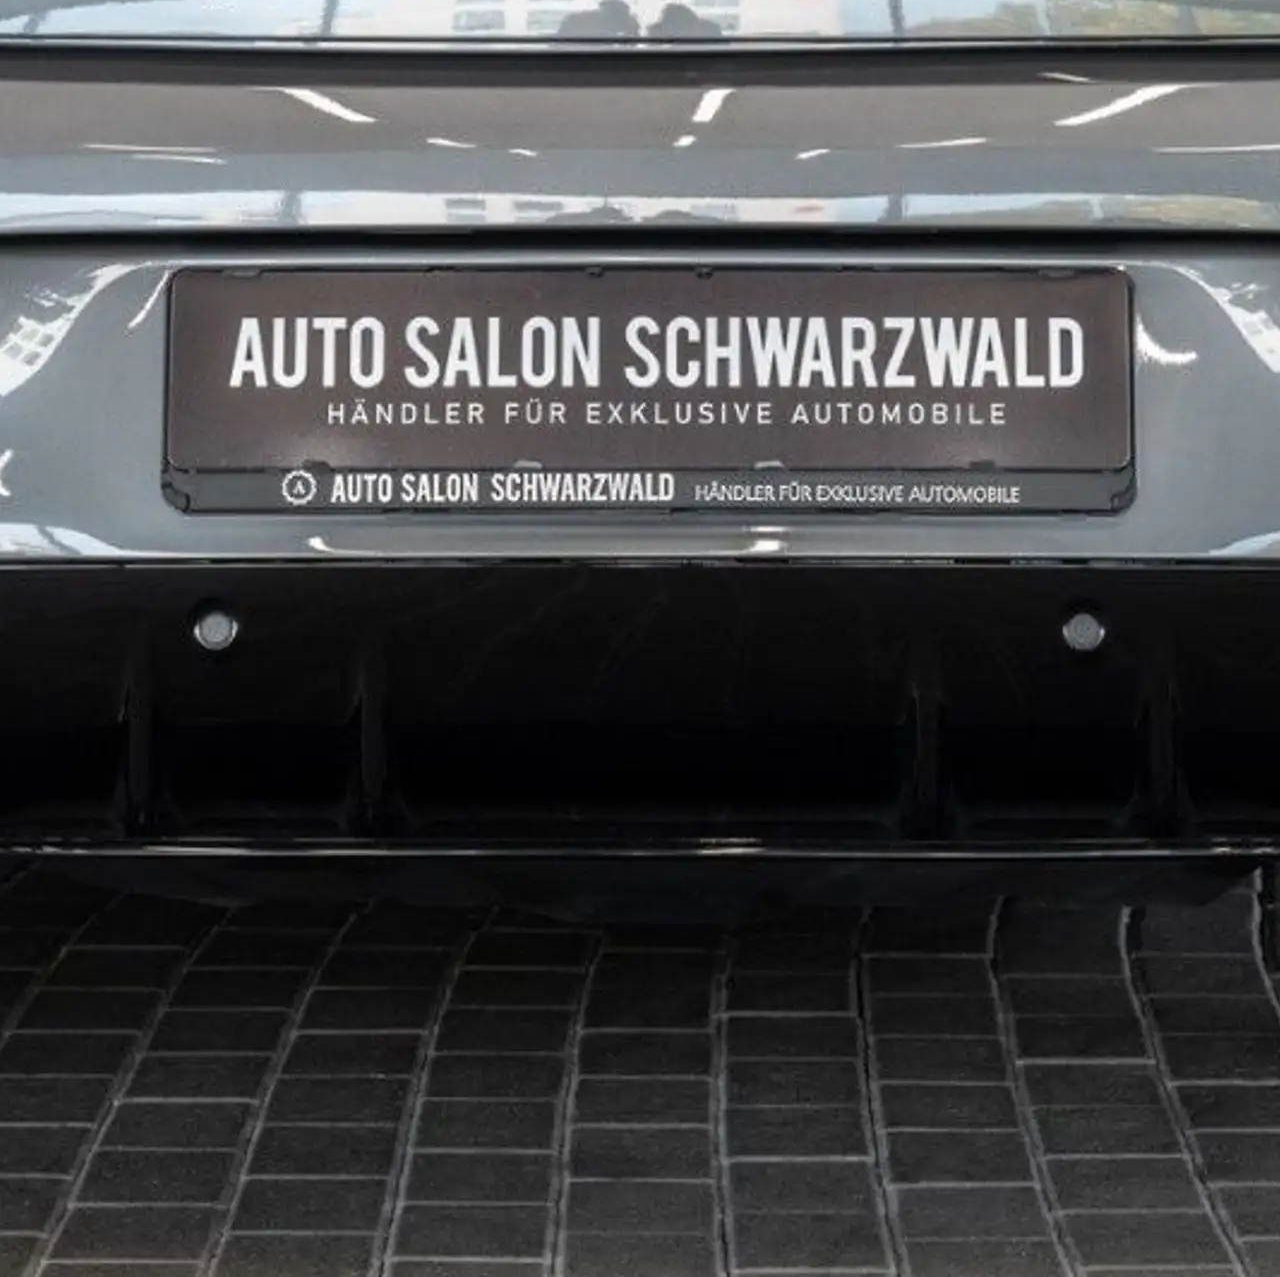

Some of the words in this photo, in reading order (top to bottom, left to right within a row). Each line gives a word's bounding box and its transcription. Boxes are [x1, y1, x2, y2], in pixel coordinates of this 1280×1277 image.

[229, 316, 385, 388] AUTO
[404, 316, 600, 389] SALON
[624, 316, 1084, 388] SCHWARZWALD
[328, 398, 484, 424] HÄNDLER
[505, 398, 567, 424] FÜR
[587, 402, 772, 424] EXKLUSIVE
[791, 402, 1006, 424] AUTOMOBILE
[330, 473, 392, 503] AUTO
[401, 473, 479, 503] SALON
[491, 472, 675, 502] SCHWARZWALD
[694, 481, 776, 502] HÄNDLER
[779, 481, 812, 502] FÜR
[815, 485, 903, 503] EXKLUSIVE
[908, 485, 1020, 504] AUTOMOBILE
